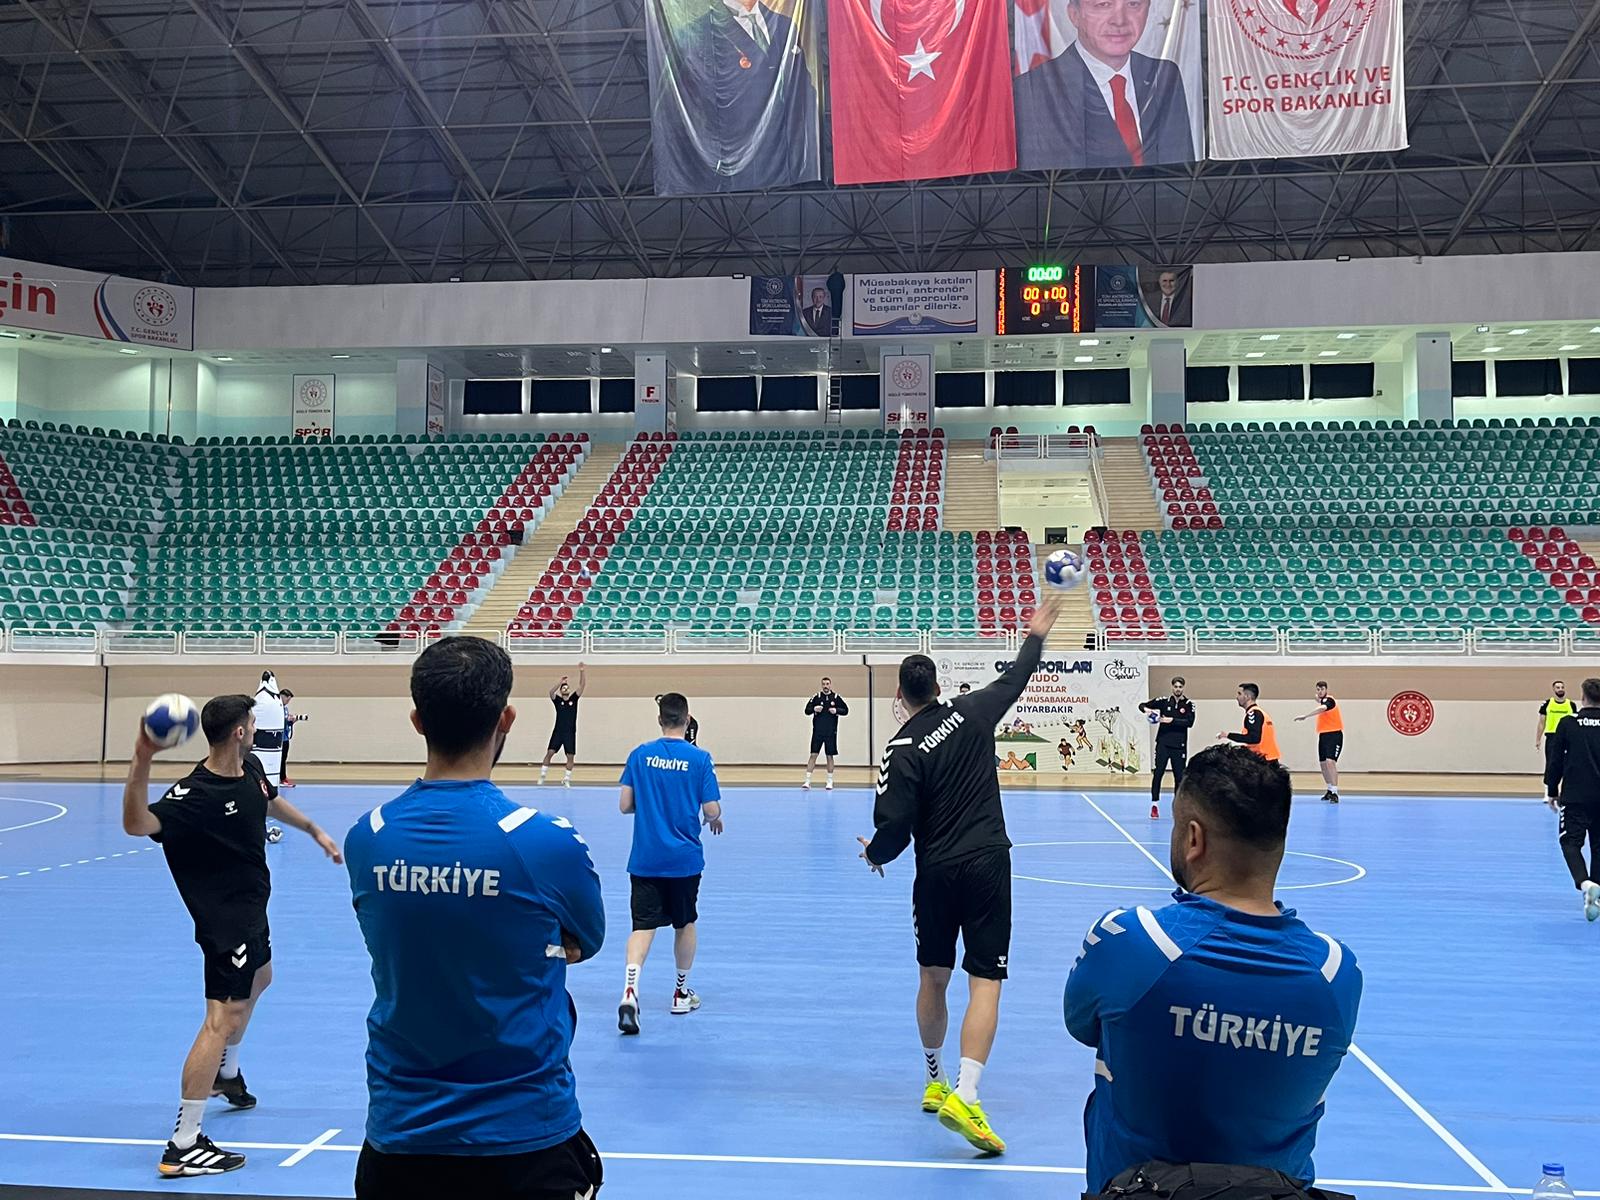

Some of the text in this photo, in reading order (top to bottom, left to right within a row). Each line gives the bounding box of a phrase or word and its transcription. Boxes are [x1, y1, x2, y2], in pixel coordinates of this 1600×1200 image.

[1222, 66, 1391, 92] T.C. GENÇLİK VE
[1222, 86, 1392, 115] SPOR BAKANLIĞI
[860, 276, 972, 287] Müsabakaya katılan
[913, 286, 965, 294] antrenör
[907, 294, 969, 304] sporculara
[870, 302, 961, 313] başarılar dileriz.
[646, 386, 656, 398] F
[1030, 674, 1060, 683] JUDO
[1026, 695, 1089, 704] MÜSABAKALARI
[1016, 705, 1073, 714] DİYARBAKIR
[918, 711, 965, 753] TÜRKİYE
[646, 755, 689, 771] TÜRKİYE
[373, 859, 500, 897] TÜRKİYE
[1169, 1003, 1323, 1057] TÜRKİYE
